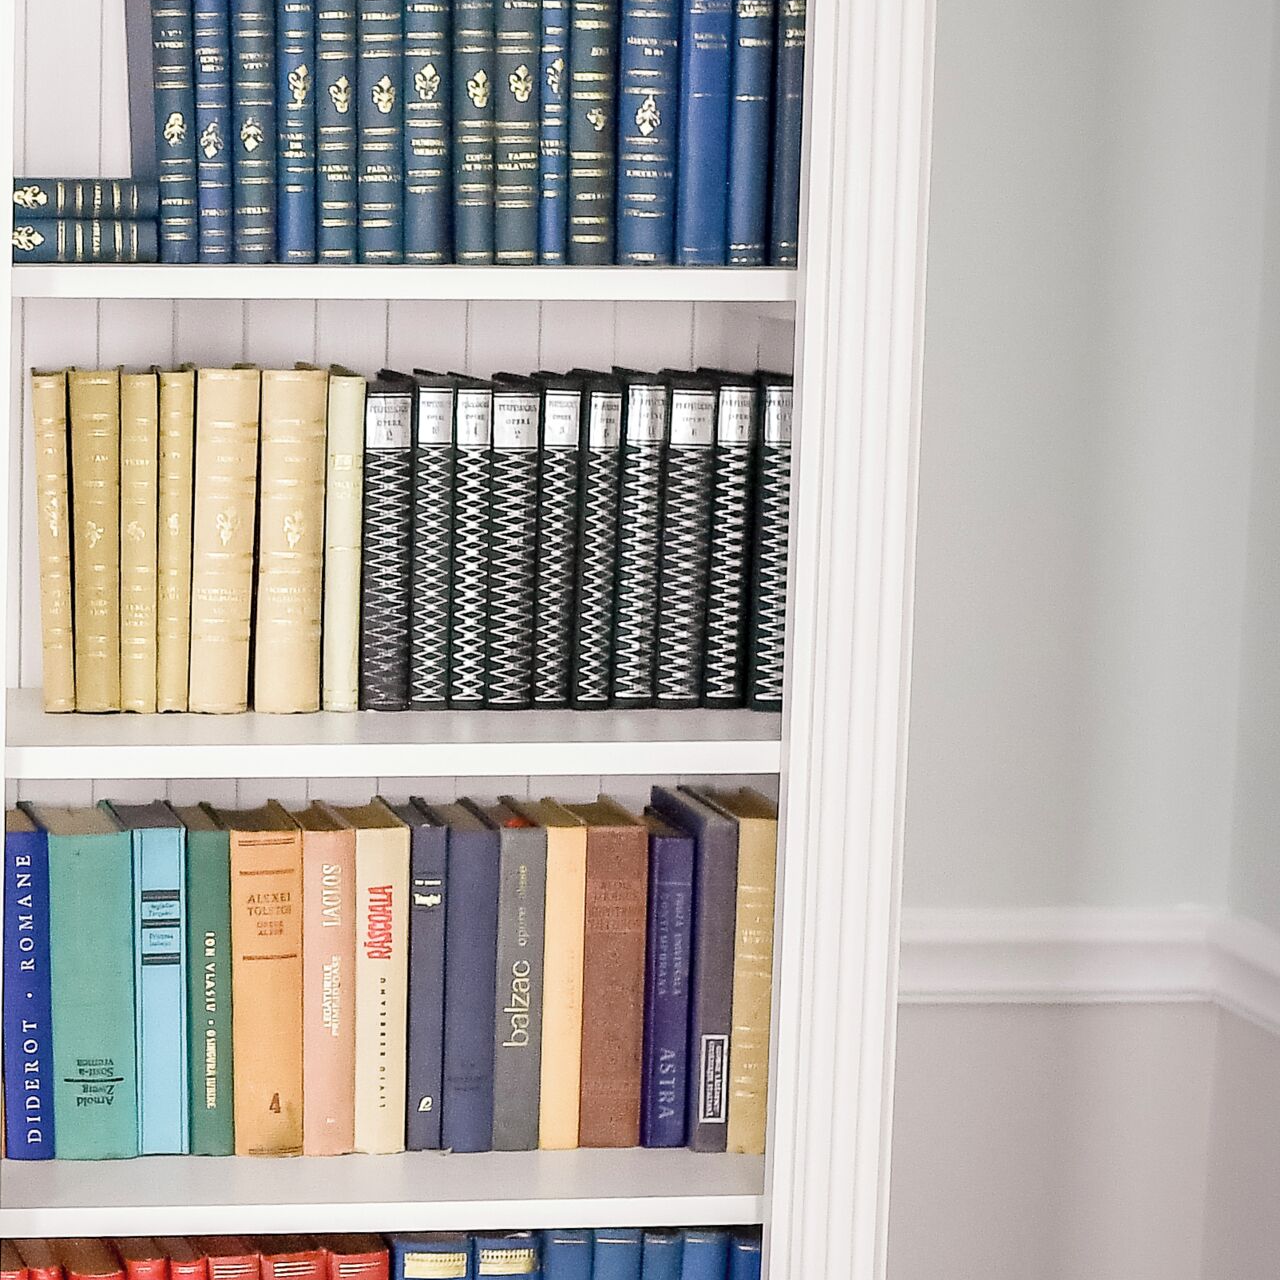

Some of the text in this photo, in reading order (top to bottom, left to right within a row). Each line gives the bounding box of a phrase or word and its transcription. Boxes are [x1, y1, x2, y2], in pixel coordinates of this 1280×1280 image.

[247, 892, 291, 904] ALEXEI
[247, 905, 292, 916] TOLSTOI
[320, 863, 343, 928] LACLOS
[204, 931, 216, 957] ION
[364, 884, 394, 961] RĂSCOALA
[15, 854, 43, 1144] DIDEROT ROMANE
[502, 959, 531, 1049] balzac
[379, 976, 387, 1110] LIVIU REBREANU
[76, 1095, 114, 1107] Arnold
[81, 1084, 115, 1095] Zweig
[268, 1092, 282, 1114] 4
[658, 1047, 677, 1119] ASTRA
